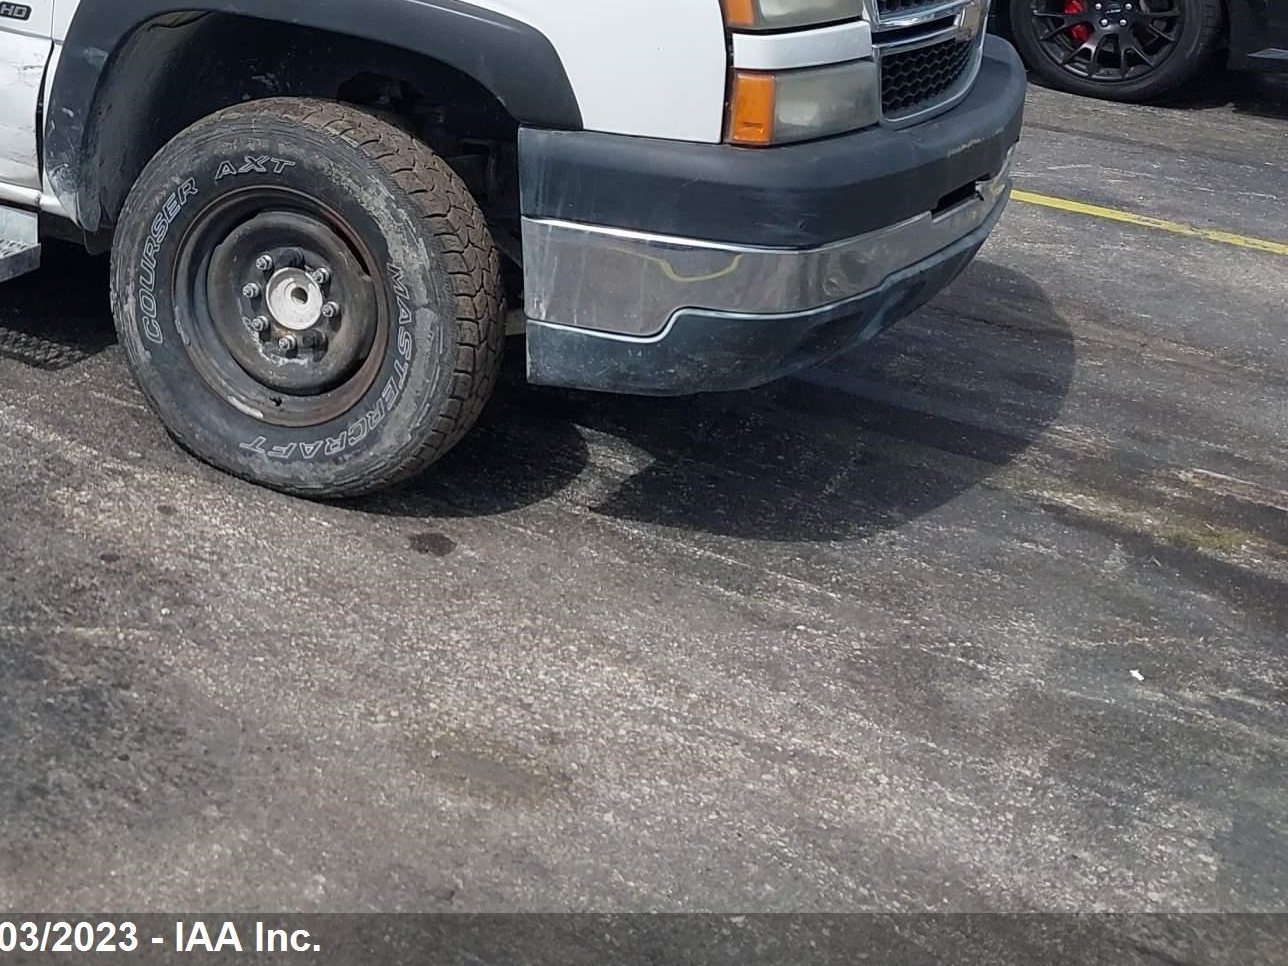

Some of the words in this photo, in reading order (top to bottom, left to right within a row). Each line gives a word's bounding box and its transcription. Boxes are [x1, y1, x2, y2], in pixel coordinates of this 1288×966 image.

[139, 177, 200, 344] COURSER
[214, 155, 296, 181] AXT
[239, 261, 412, 459] MASTERCRAFT
